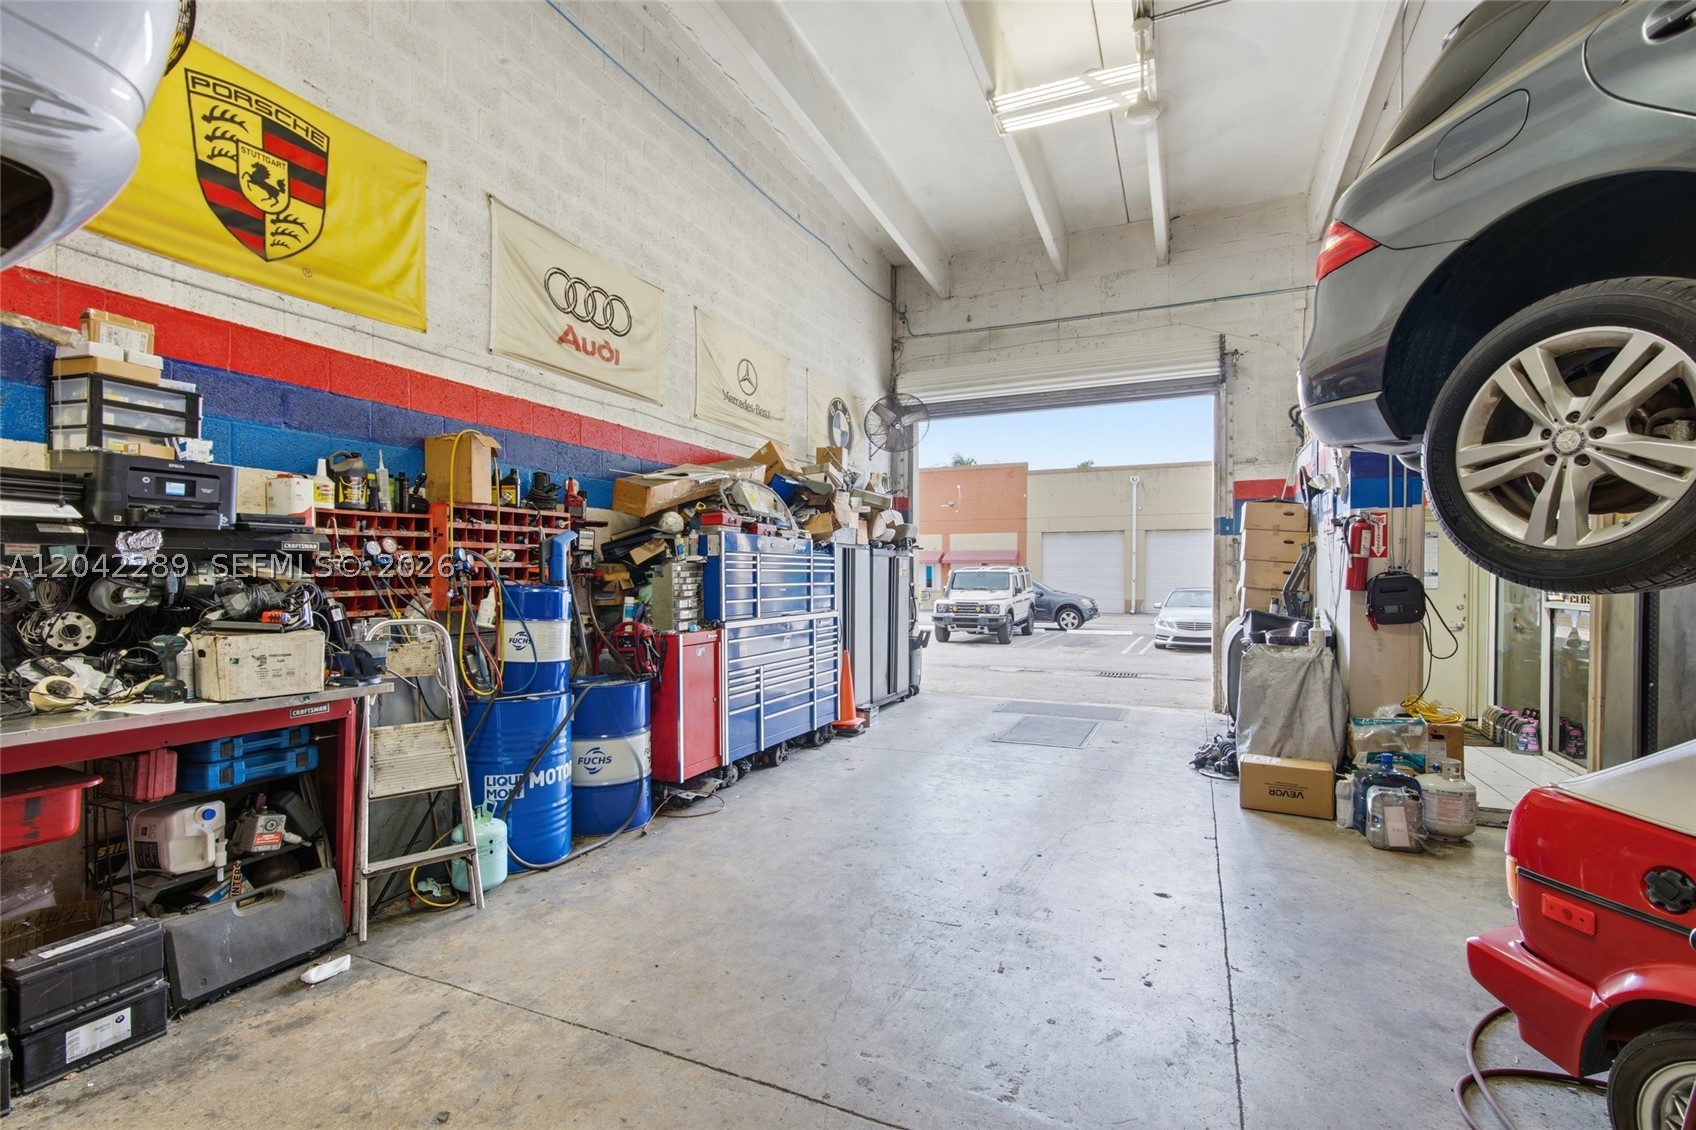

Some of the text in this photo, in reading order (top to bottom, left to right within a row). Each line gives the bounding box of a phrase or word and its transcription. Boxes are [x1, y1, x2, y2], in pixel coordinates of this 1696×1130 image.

[190, 75, 325, 148] PORSCHE
[241, 146, 287, 170] STUTTGART
[556, 323, 620, 366] Audi
[828, 401, 852, 423] BMW
[283, 542, 318, 550] CRAFTSMAN
[292, 705, 327, 717] CRAFTSMAN
[577, 755, 613, 766] FUCHS
[1268, 788, 1305, 800] VEVOR
